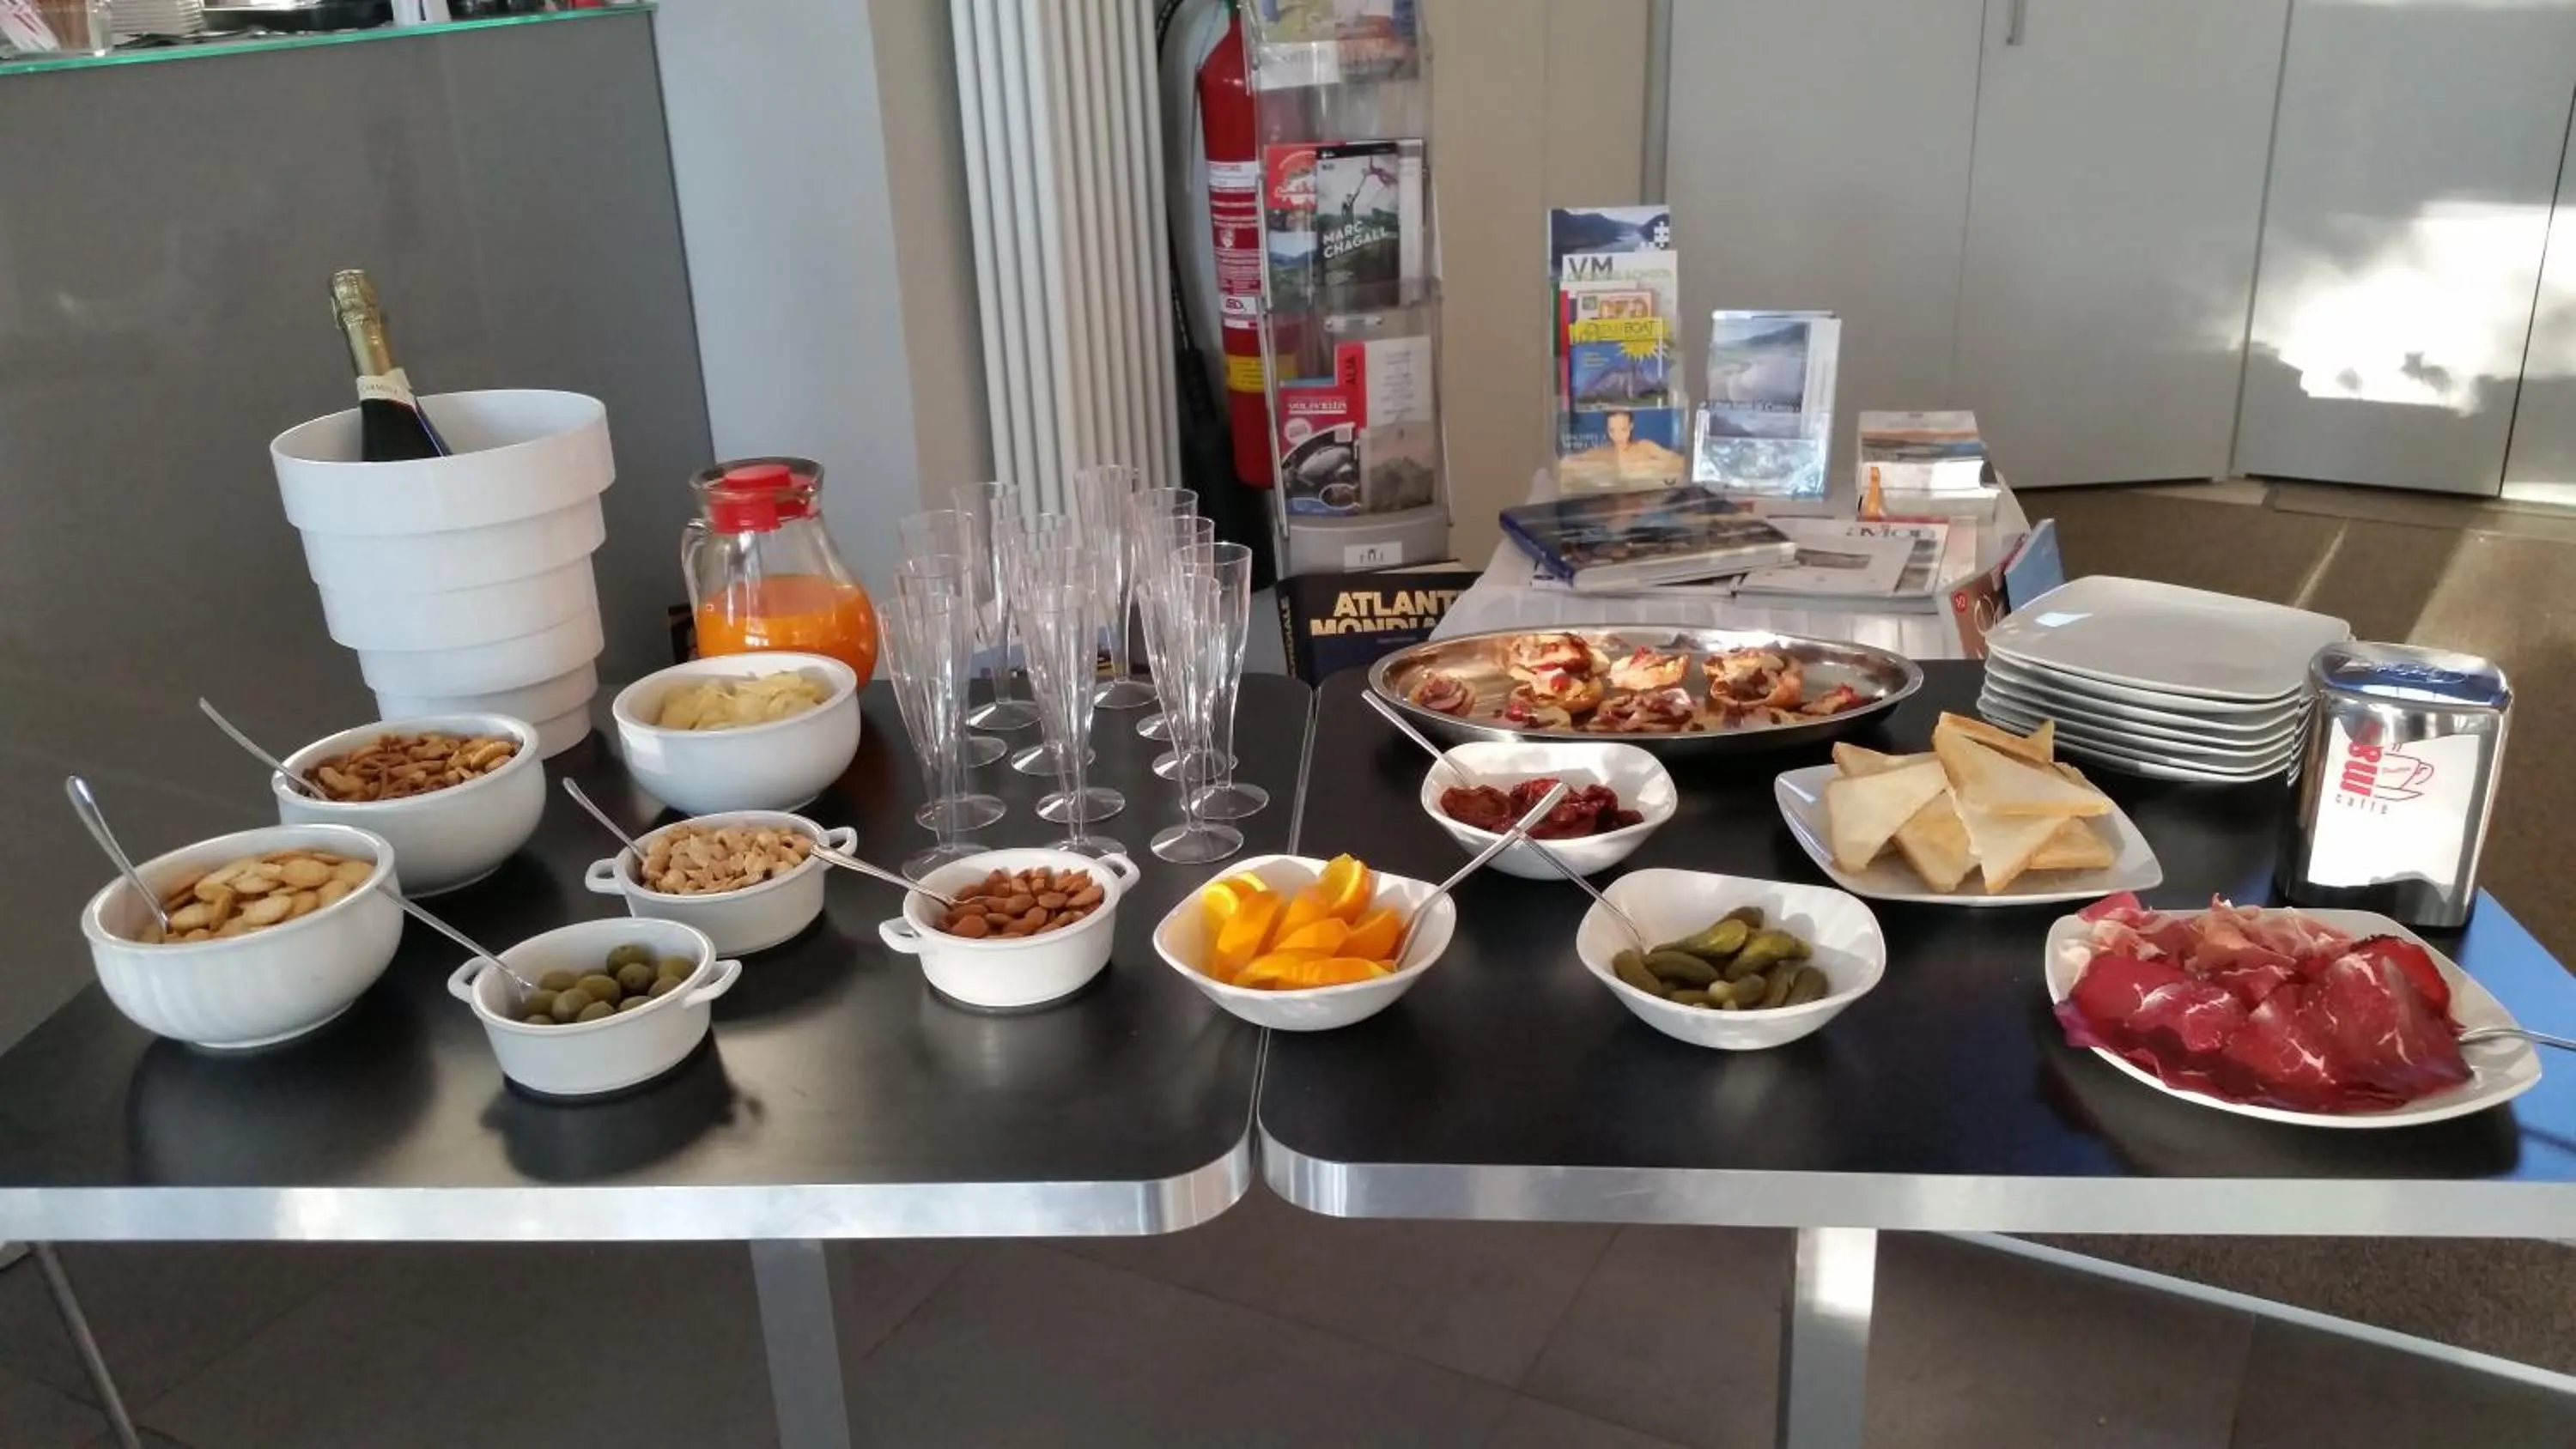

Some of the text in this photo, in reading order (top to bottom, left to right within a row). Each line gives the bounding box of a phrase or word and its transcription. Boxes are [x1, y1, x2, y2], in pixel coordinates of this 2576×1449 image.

[1322, 220, 1364, 246] MARC
[1323, 226, 1388, 259] CHAGALL
[1568, 256, 1613, 281] VM
